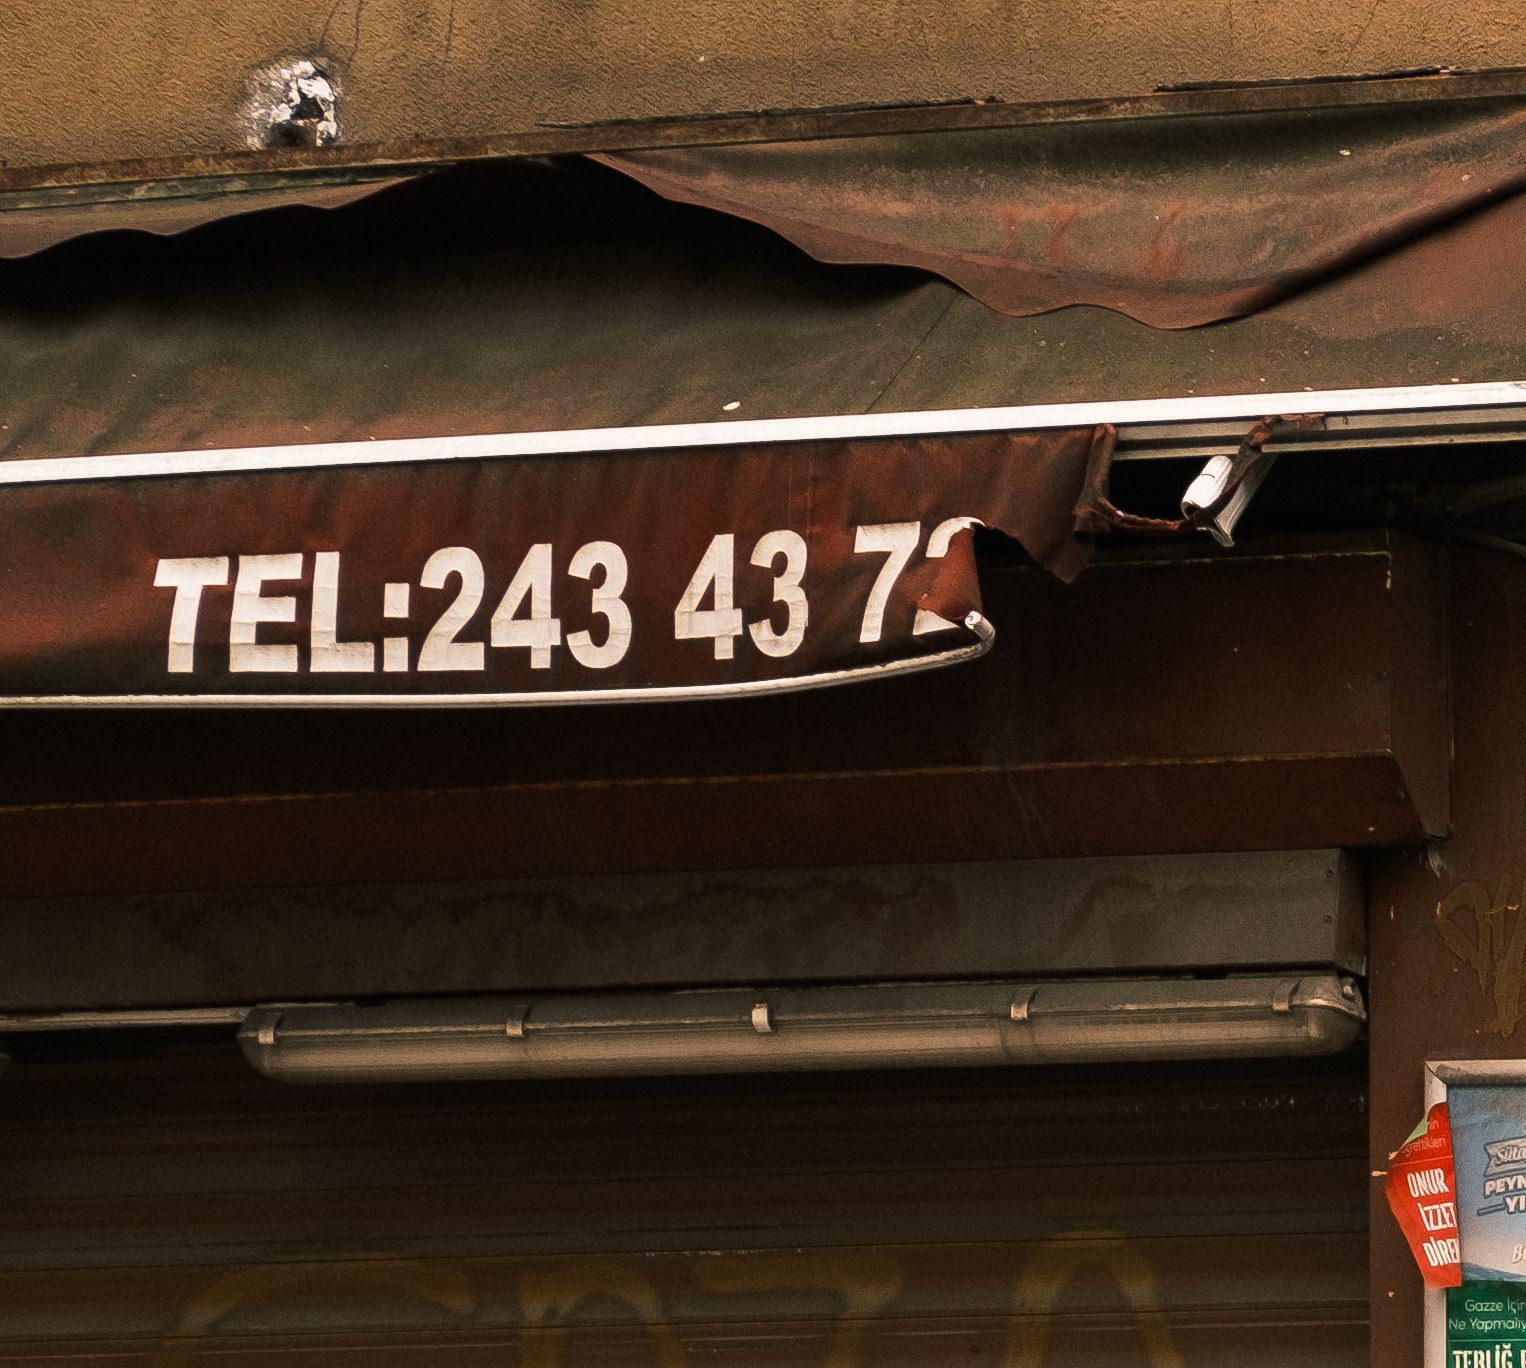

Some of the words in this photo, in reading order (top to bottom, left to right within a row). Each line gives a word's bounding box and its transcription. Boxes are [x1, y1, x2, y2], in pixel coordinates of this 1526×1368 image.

[674, 529, 807, 660] 43
[1407, 1168, 1449, 1198] ONUR
[1449, 1318, 1464, 1330] Ne
